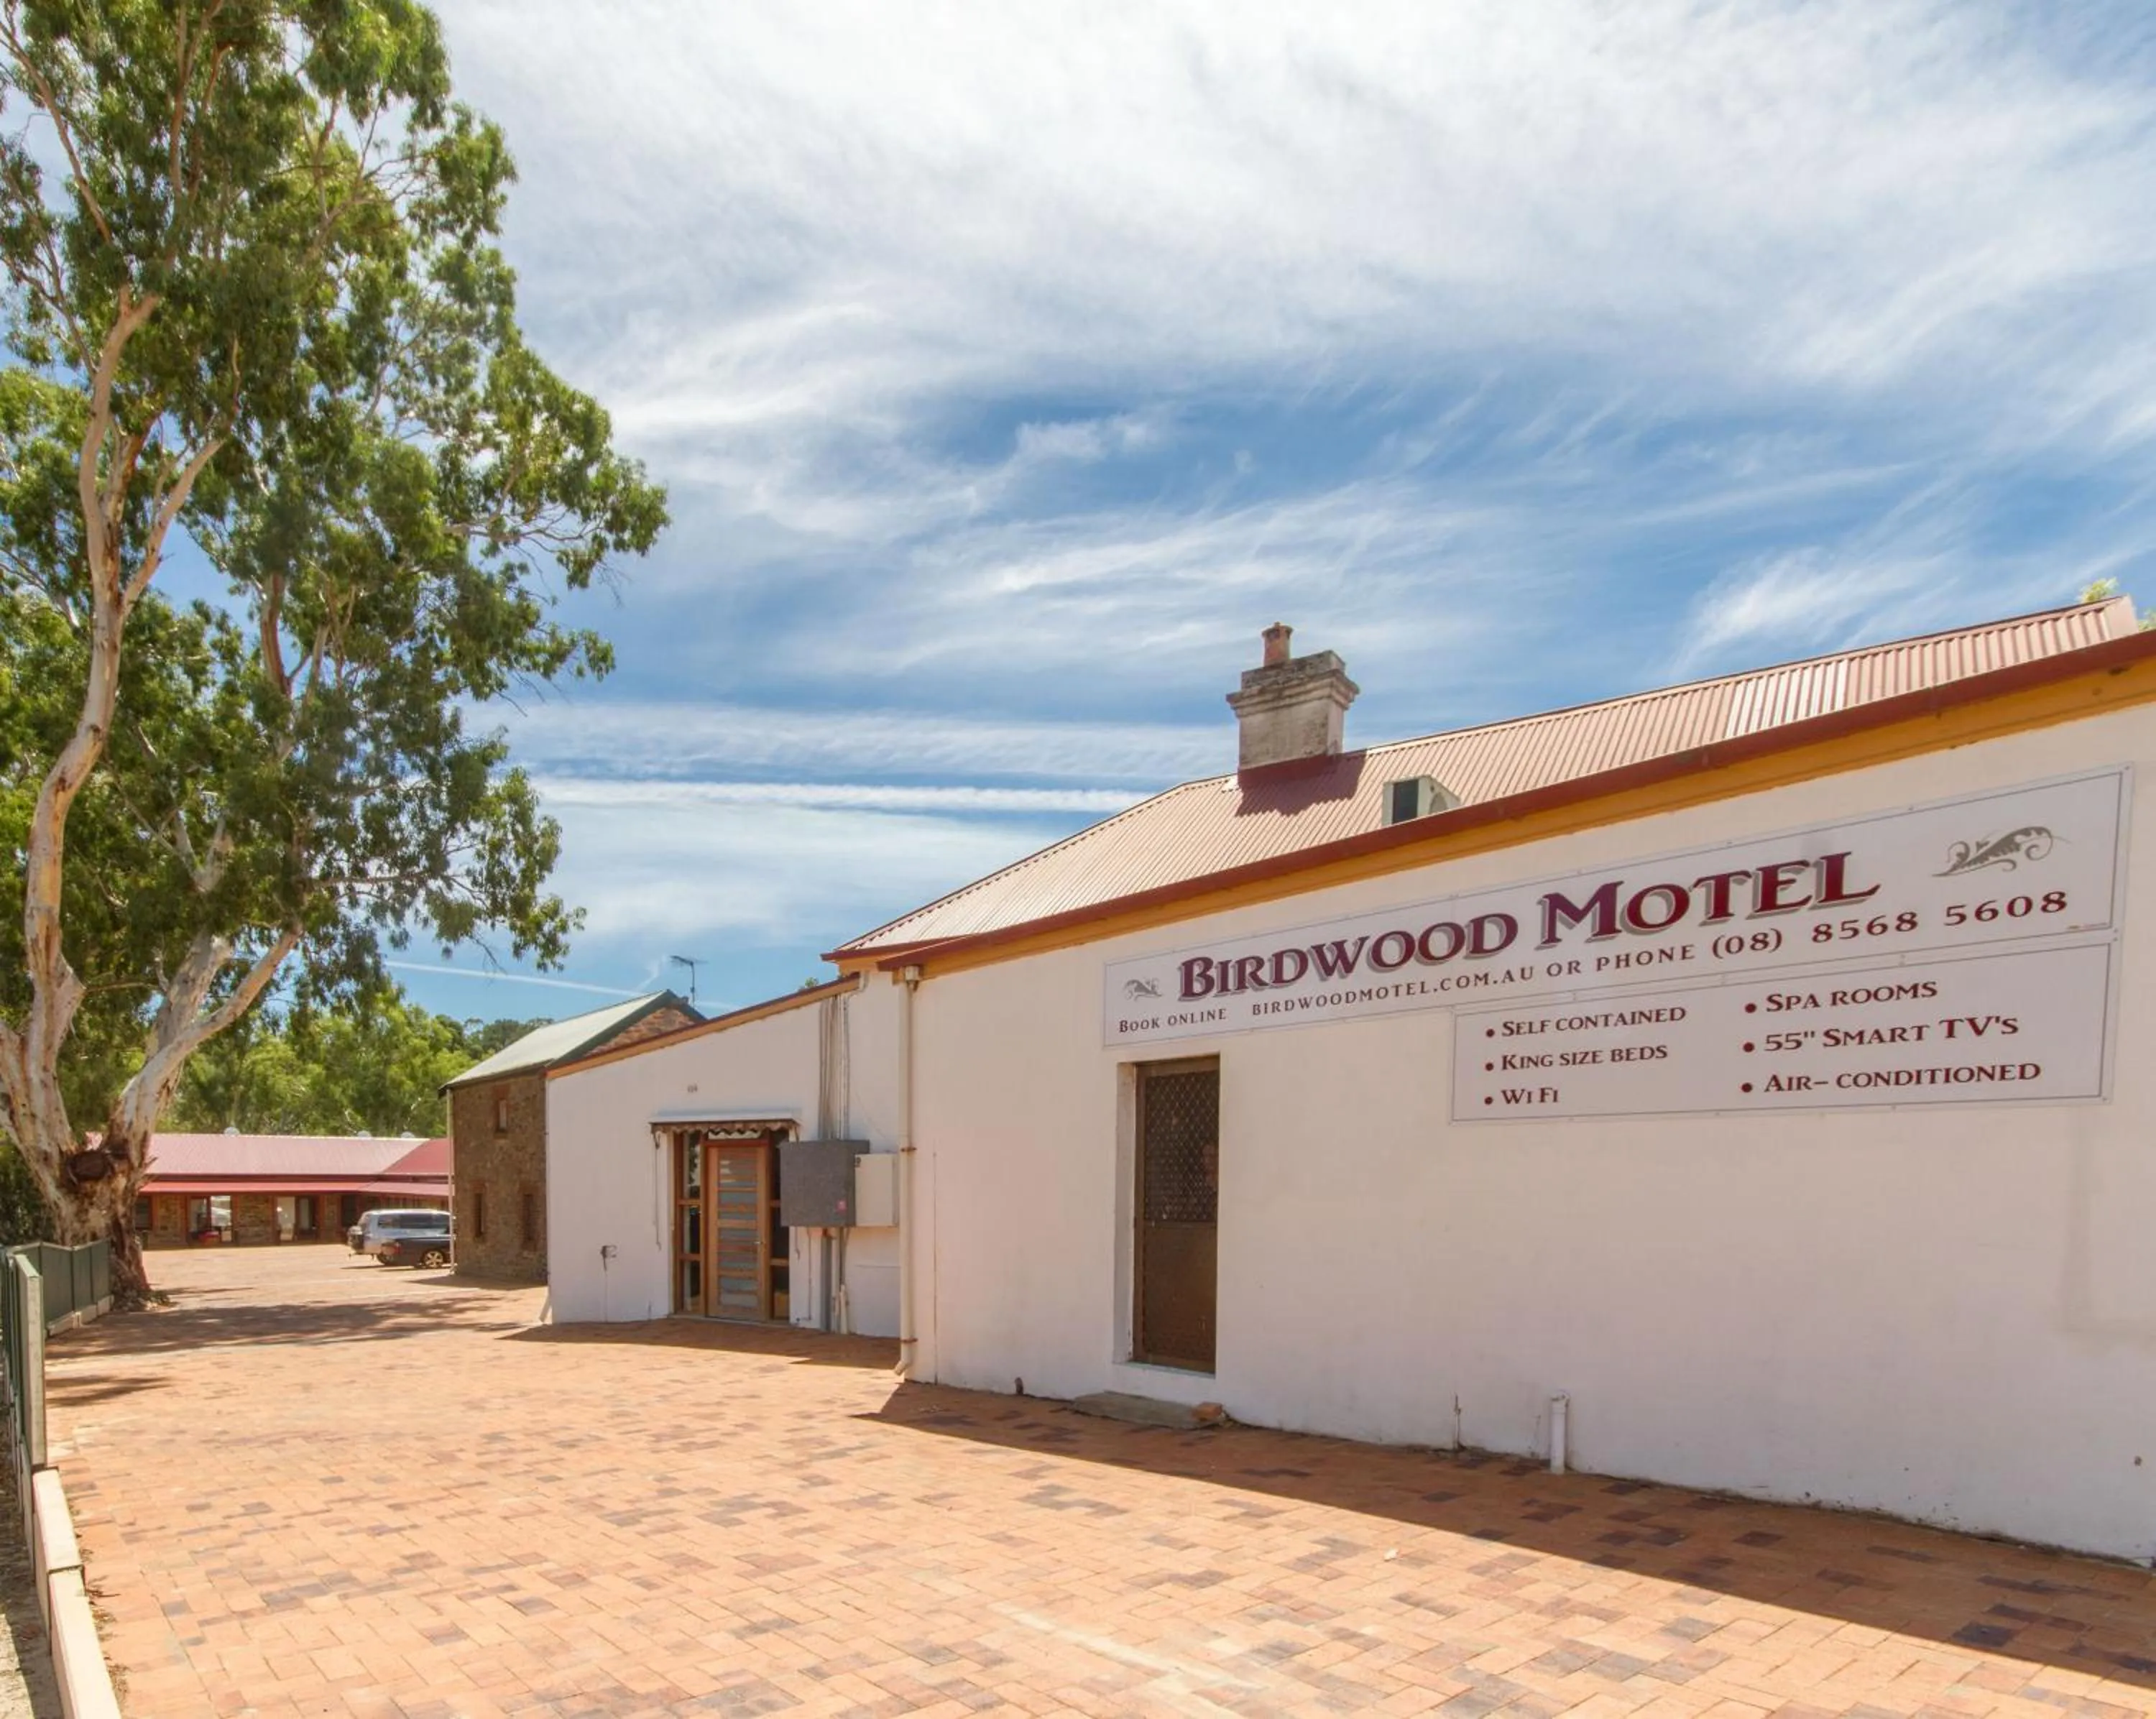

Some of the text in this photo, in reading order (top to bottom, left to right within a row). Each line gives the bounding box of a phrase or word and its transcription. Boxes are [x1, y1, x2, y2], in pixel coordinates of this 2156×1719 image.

[1177, 851, 1881, 1003] BIRDWOOD MOTEL
[1118, 890, 2068, 1033] BOOK ONLINE BIRDWOODMOTEL.COM.AU OR PHONE (08) 8568 5608
[1766, 981, 1938, 1013] SPA ROOMS
[1501, 1006, 1687, 1037] SELF CONTAINED
[1822, 1024, 1930, 1048] SMART
[1501, 1044, 1669, 1072] KING SIZE BEDS
[1835, 1062, 2042, 1089] CONDITIONED
